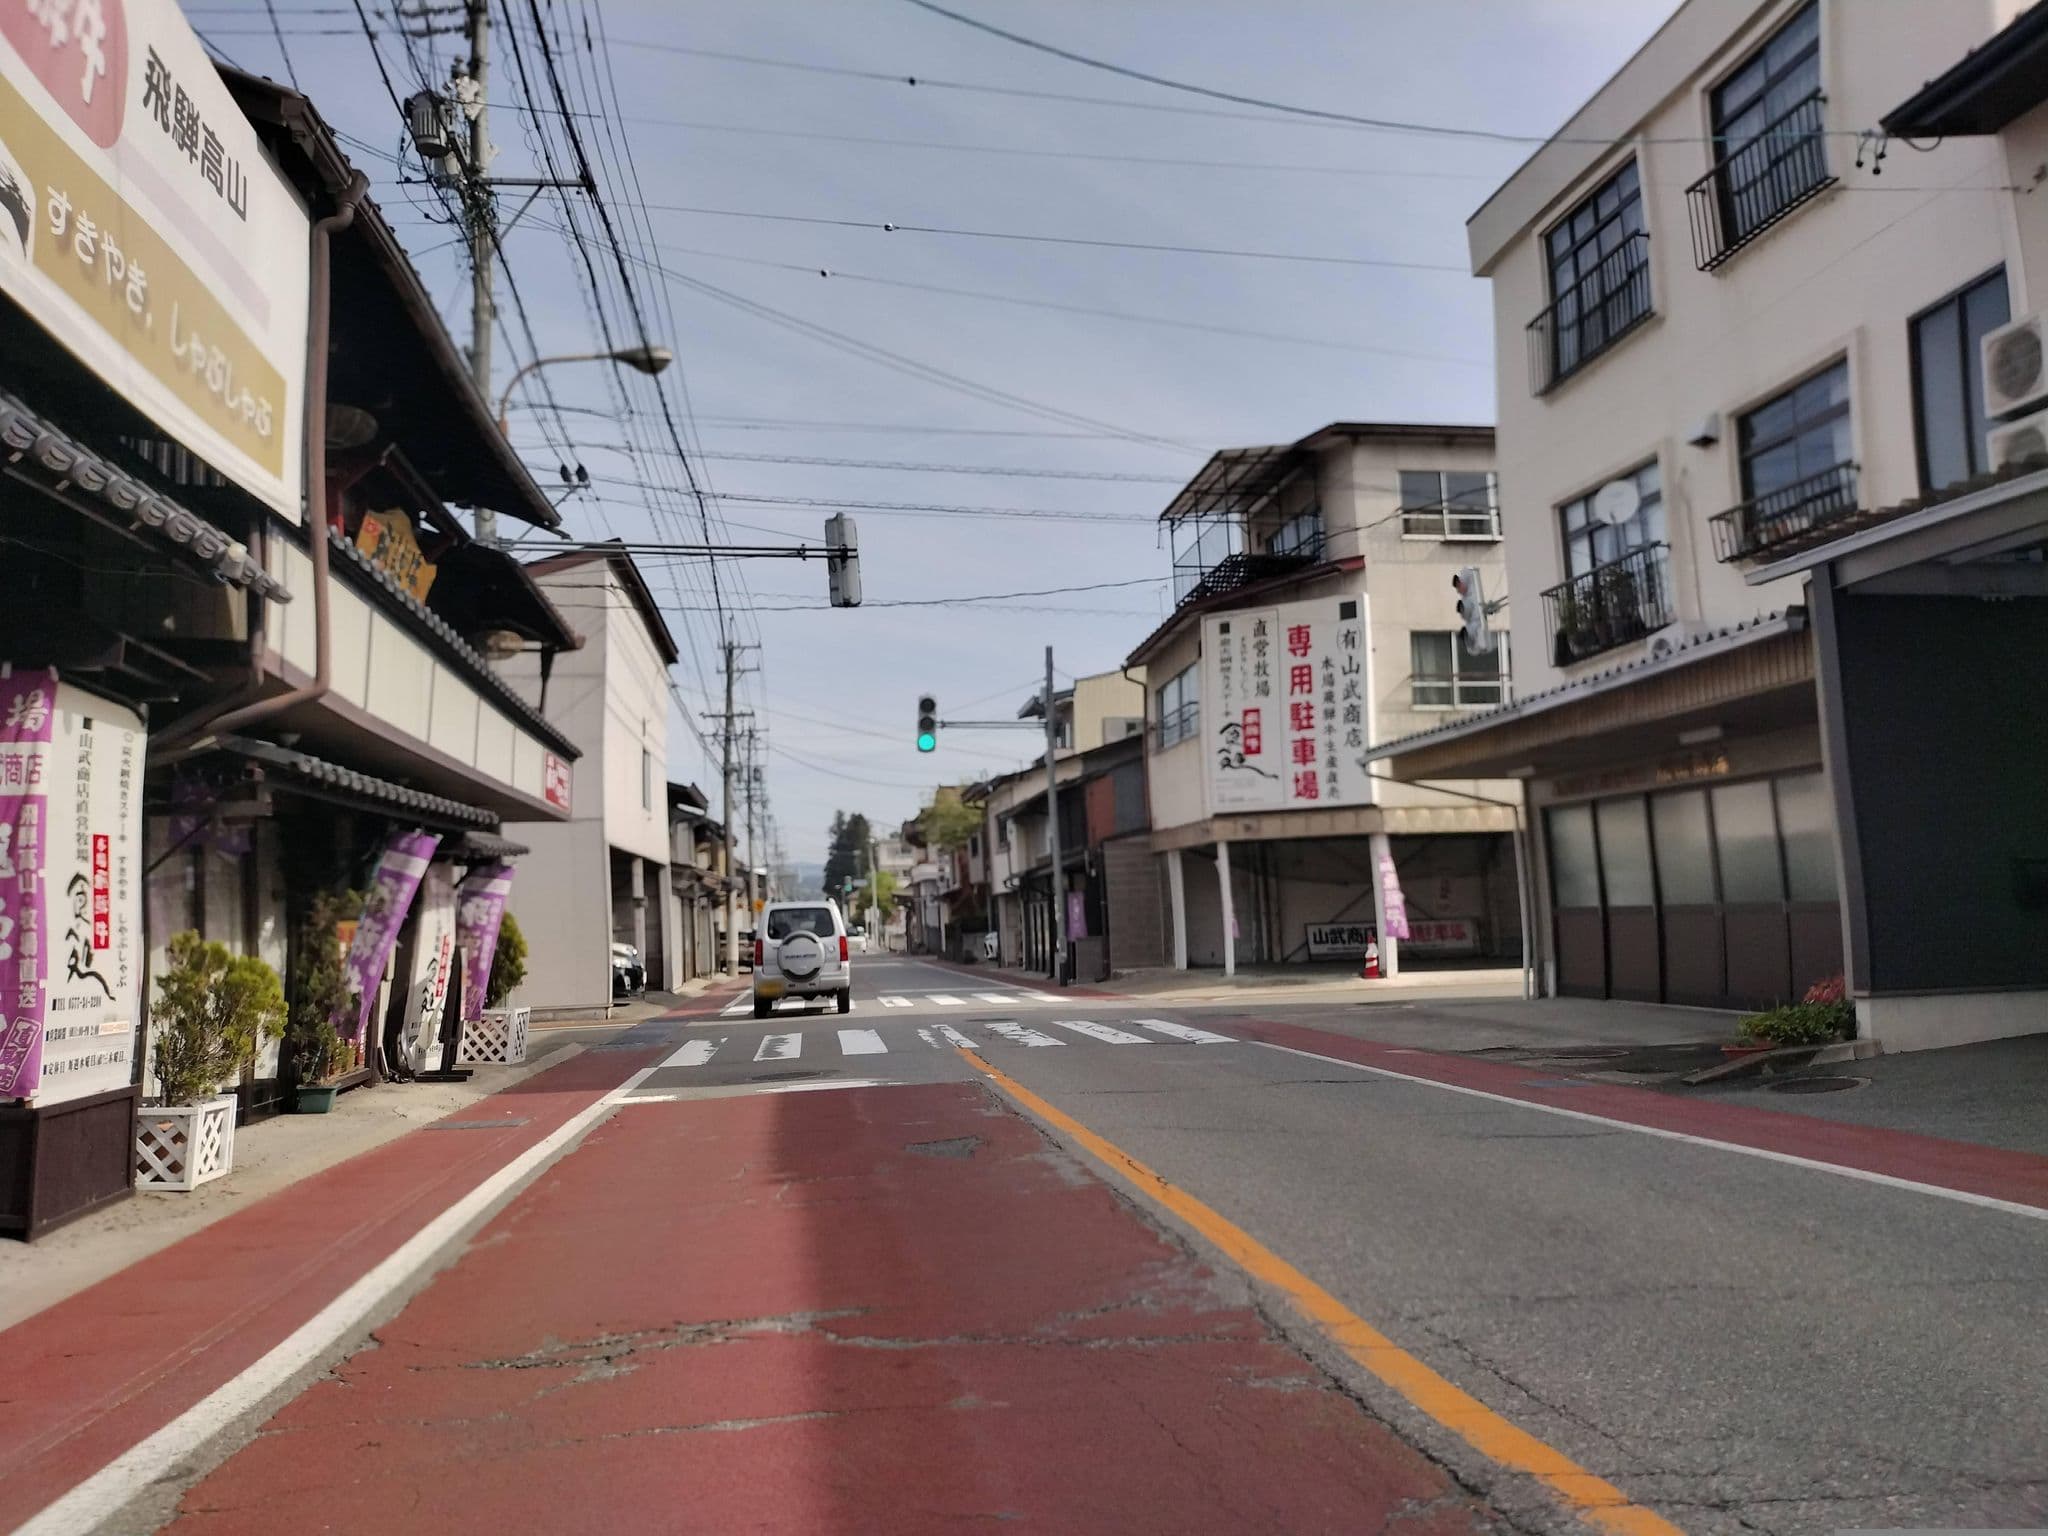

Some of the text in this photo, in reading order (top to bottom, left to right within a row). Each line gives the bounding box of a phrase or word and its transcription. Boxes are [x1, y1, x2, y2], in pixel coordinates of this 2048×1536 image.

[143, 44, 247, 222] 飛騨高山
[1287, 624, 1318, 799] 専用駐車場
